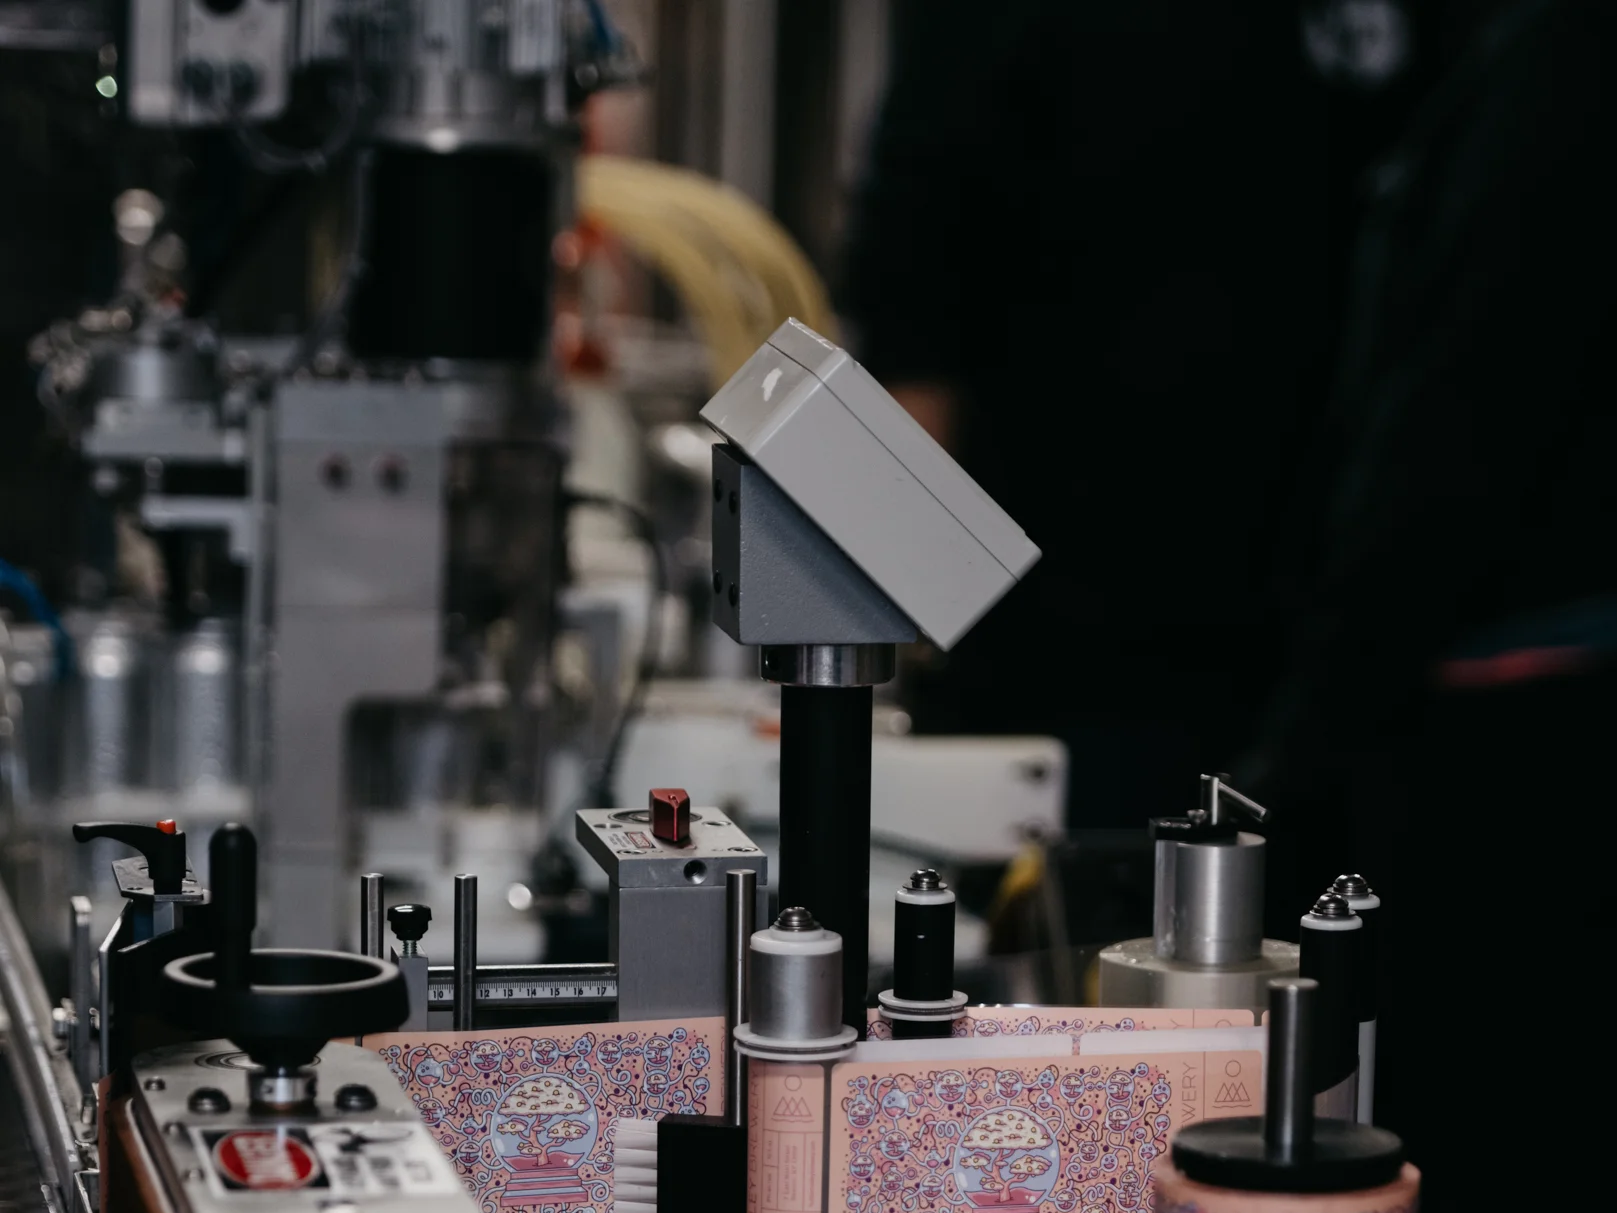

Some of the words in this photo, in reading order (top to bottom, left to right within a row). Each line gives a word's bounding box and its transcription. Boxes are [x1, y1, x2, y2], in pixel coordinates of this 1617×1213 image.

[433, 991, 444, 999] 10
[480, 989, 490, 998] 12
[503, 988, 514, 997] 13
[526, 988, 537, 997] 14
[550, 987, 560, 996] 15
[573, 987, 584, 996] 16
[596, 986, 607, 996] 17
[747, 1069, 759, 1173] BREWERY
[1182, 1062, 1197, 1126] WERY
